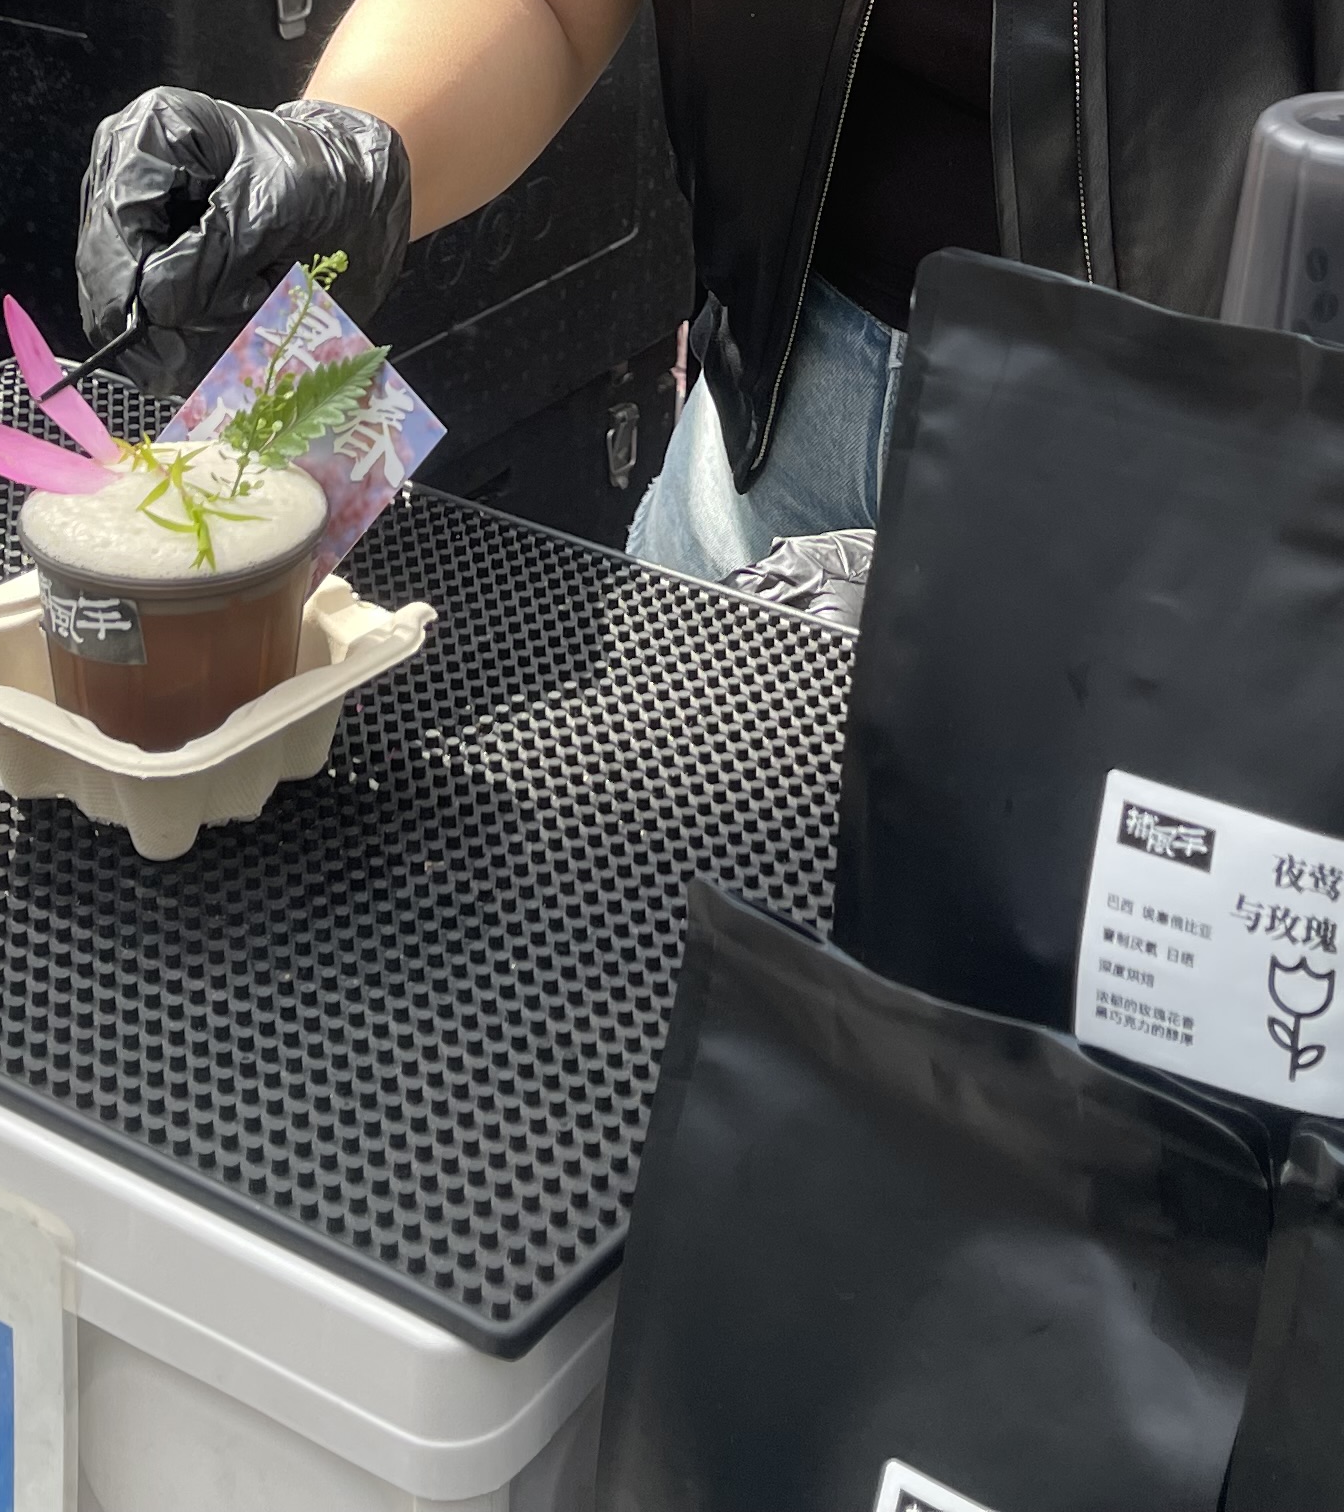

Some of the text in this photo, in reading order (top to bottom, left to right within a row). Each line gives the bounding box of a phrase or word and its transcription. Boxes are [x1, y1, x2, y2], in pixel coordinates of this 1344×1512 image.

[1273, 854, 1344, 902] 夜莺
[1107, 893, 1134, 915] 巴西
[1229, 893, 1338, 955] 与玫瑰
